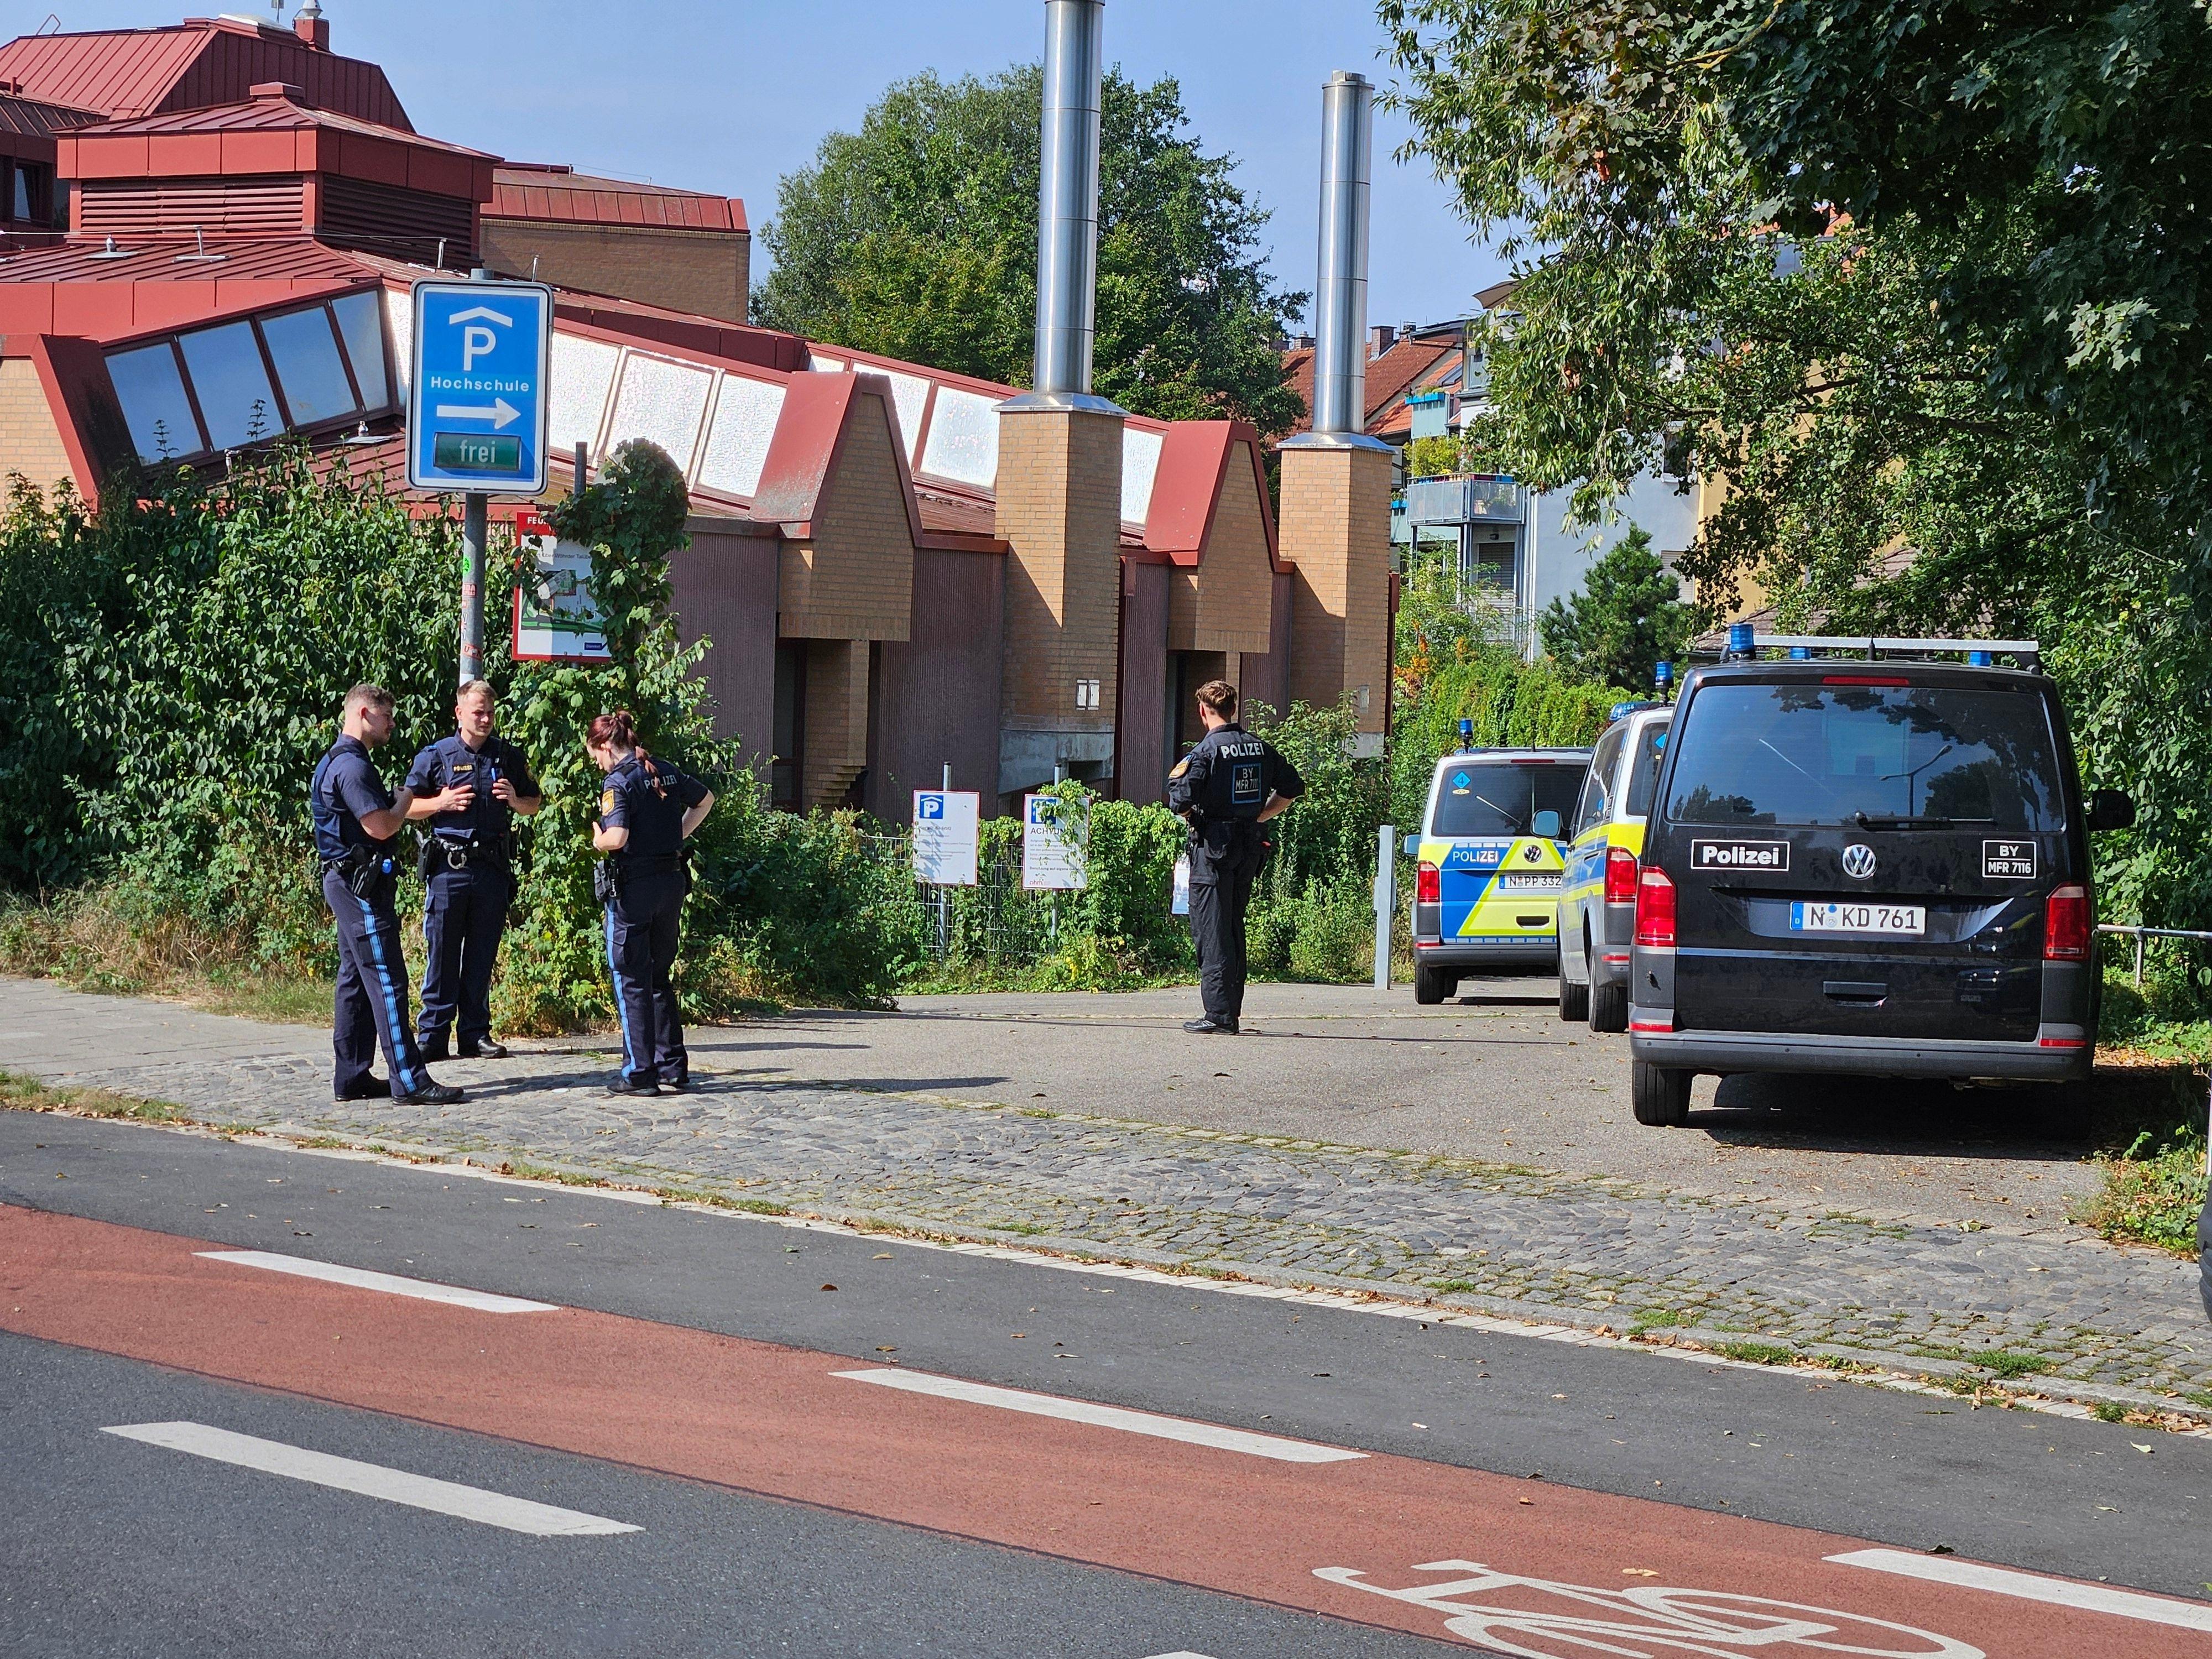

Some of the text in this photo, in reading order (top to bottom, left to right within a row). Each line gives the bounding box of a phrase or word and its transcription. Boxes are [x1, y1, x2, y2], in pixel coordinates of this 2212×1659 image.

[463, 326, 496, 371] P
[431, 376, 529, 392] Hochschule
[459, 440, 495, 463] frei
[527, 517, 549, 525] FEU
[1220, 743, 1264, 759] POLIZEI
[1243, 767, 1254, 779] BY
[1235, 779, 1249, 790] MFR
[1458, 776, 1464, 785] 4
[1453, 851, 1498, 862] POLIZEI
[1703, 846, 1780, 864] Polizei
[2000, 845, 2019, 857] BY
[1988, 861, 2032, 874] MFR 7116
[1510, 876, 1561, 886] N PP 332
[1811, 906, 1824, 926] N
[1842, 907, 1870, 927] KD
[1878, 909, 1918, 929] 761
